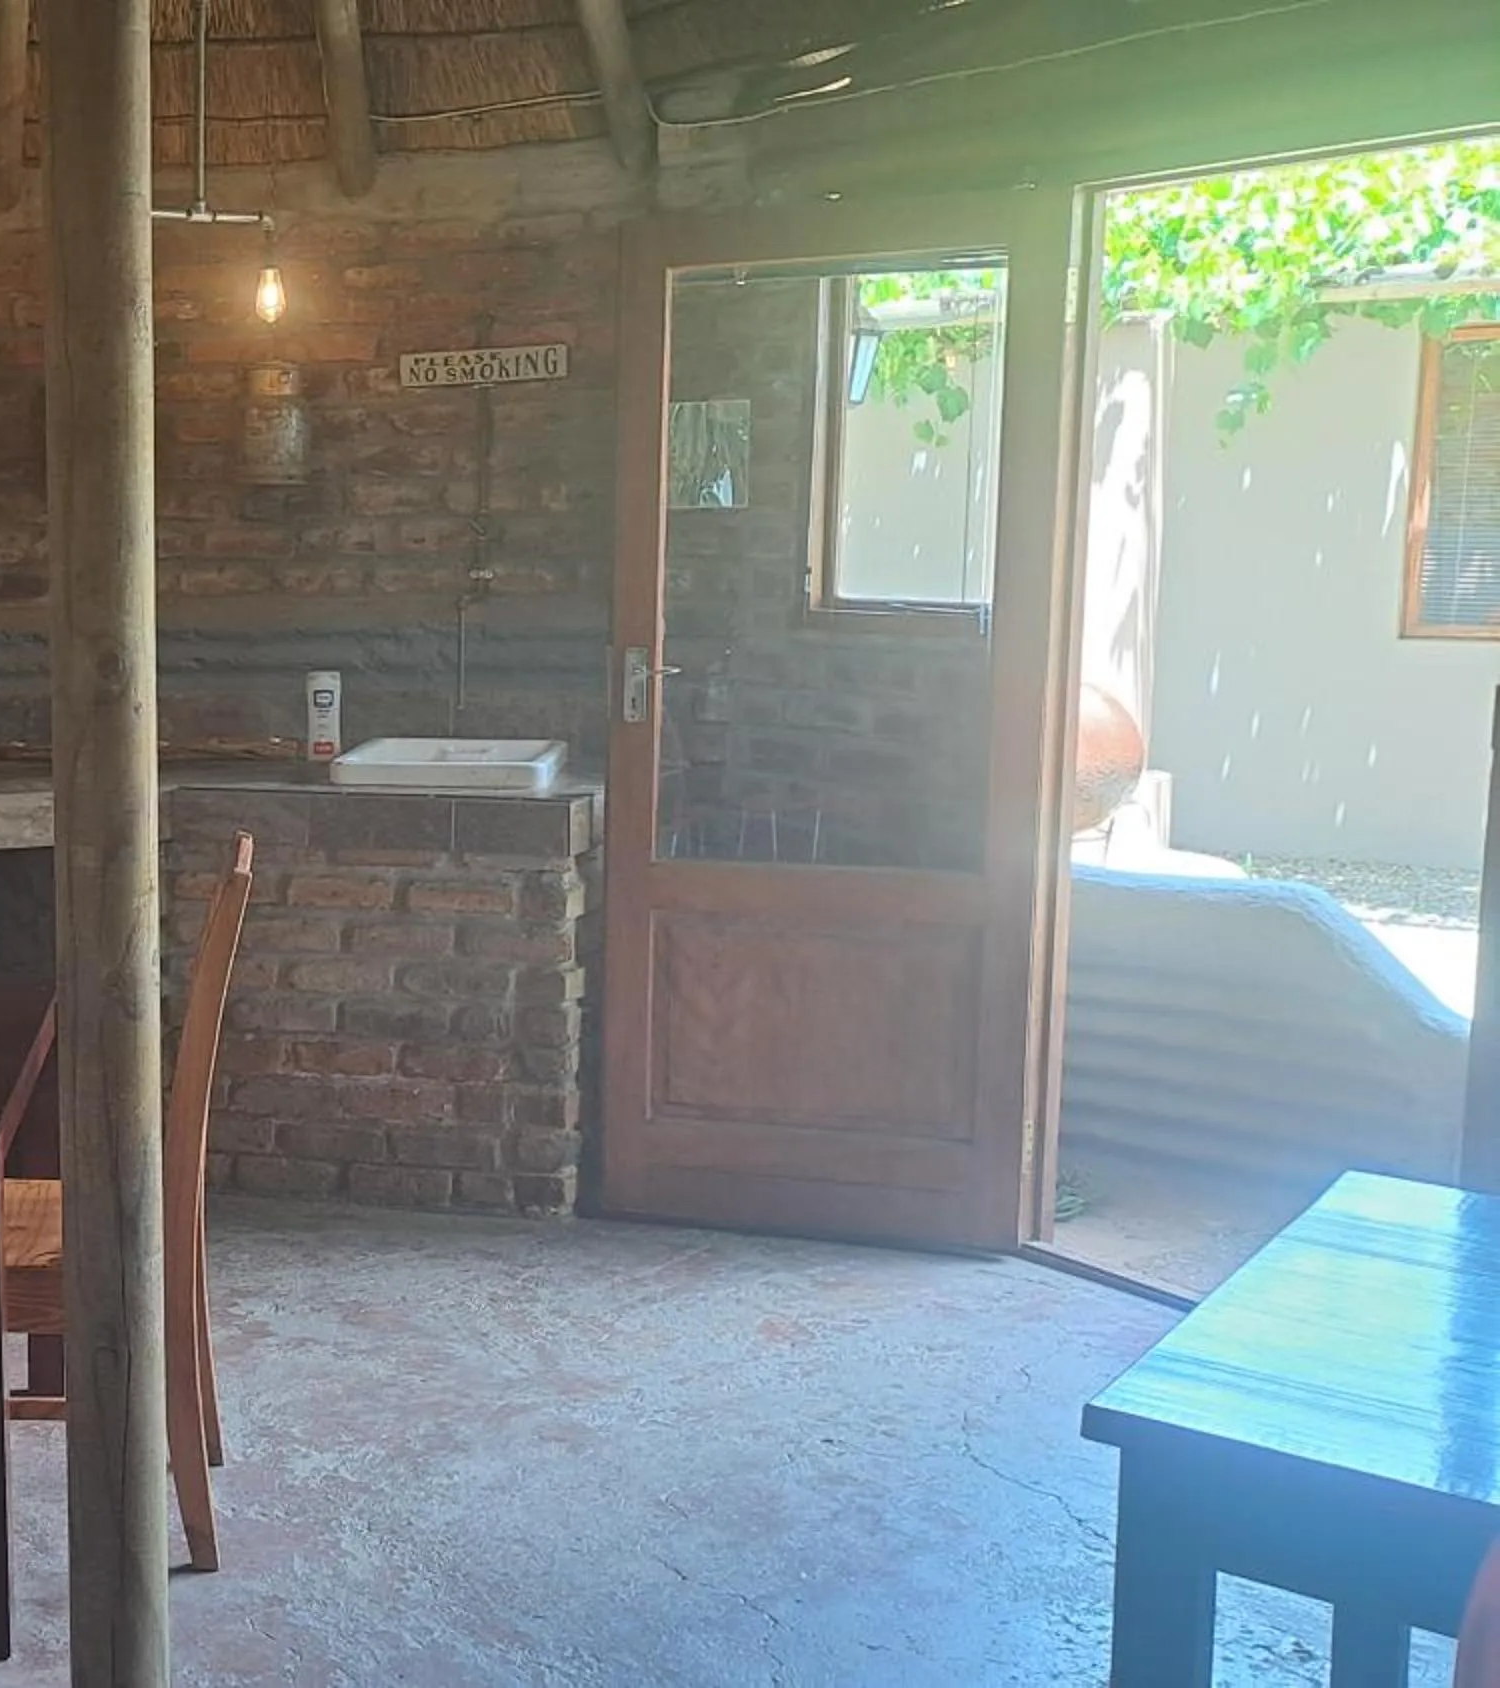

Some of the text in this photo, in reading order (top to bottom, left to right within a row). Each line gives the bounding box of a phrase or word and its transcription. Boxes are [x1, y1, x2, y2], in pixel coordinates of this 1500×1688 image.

[409, 347, 558, 382] NO SMOKING
[413, 351, 501, 366] PLEASE
